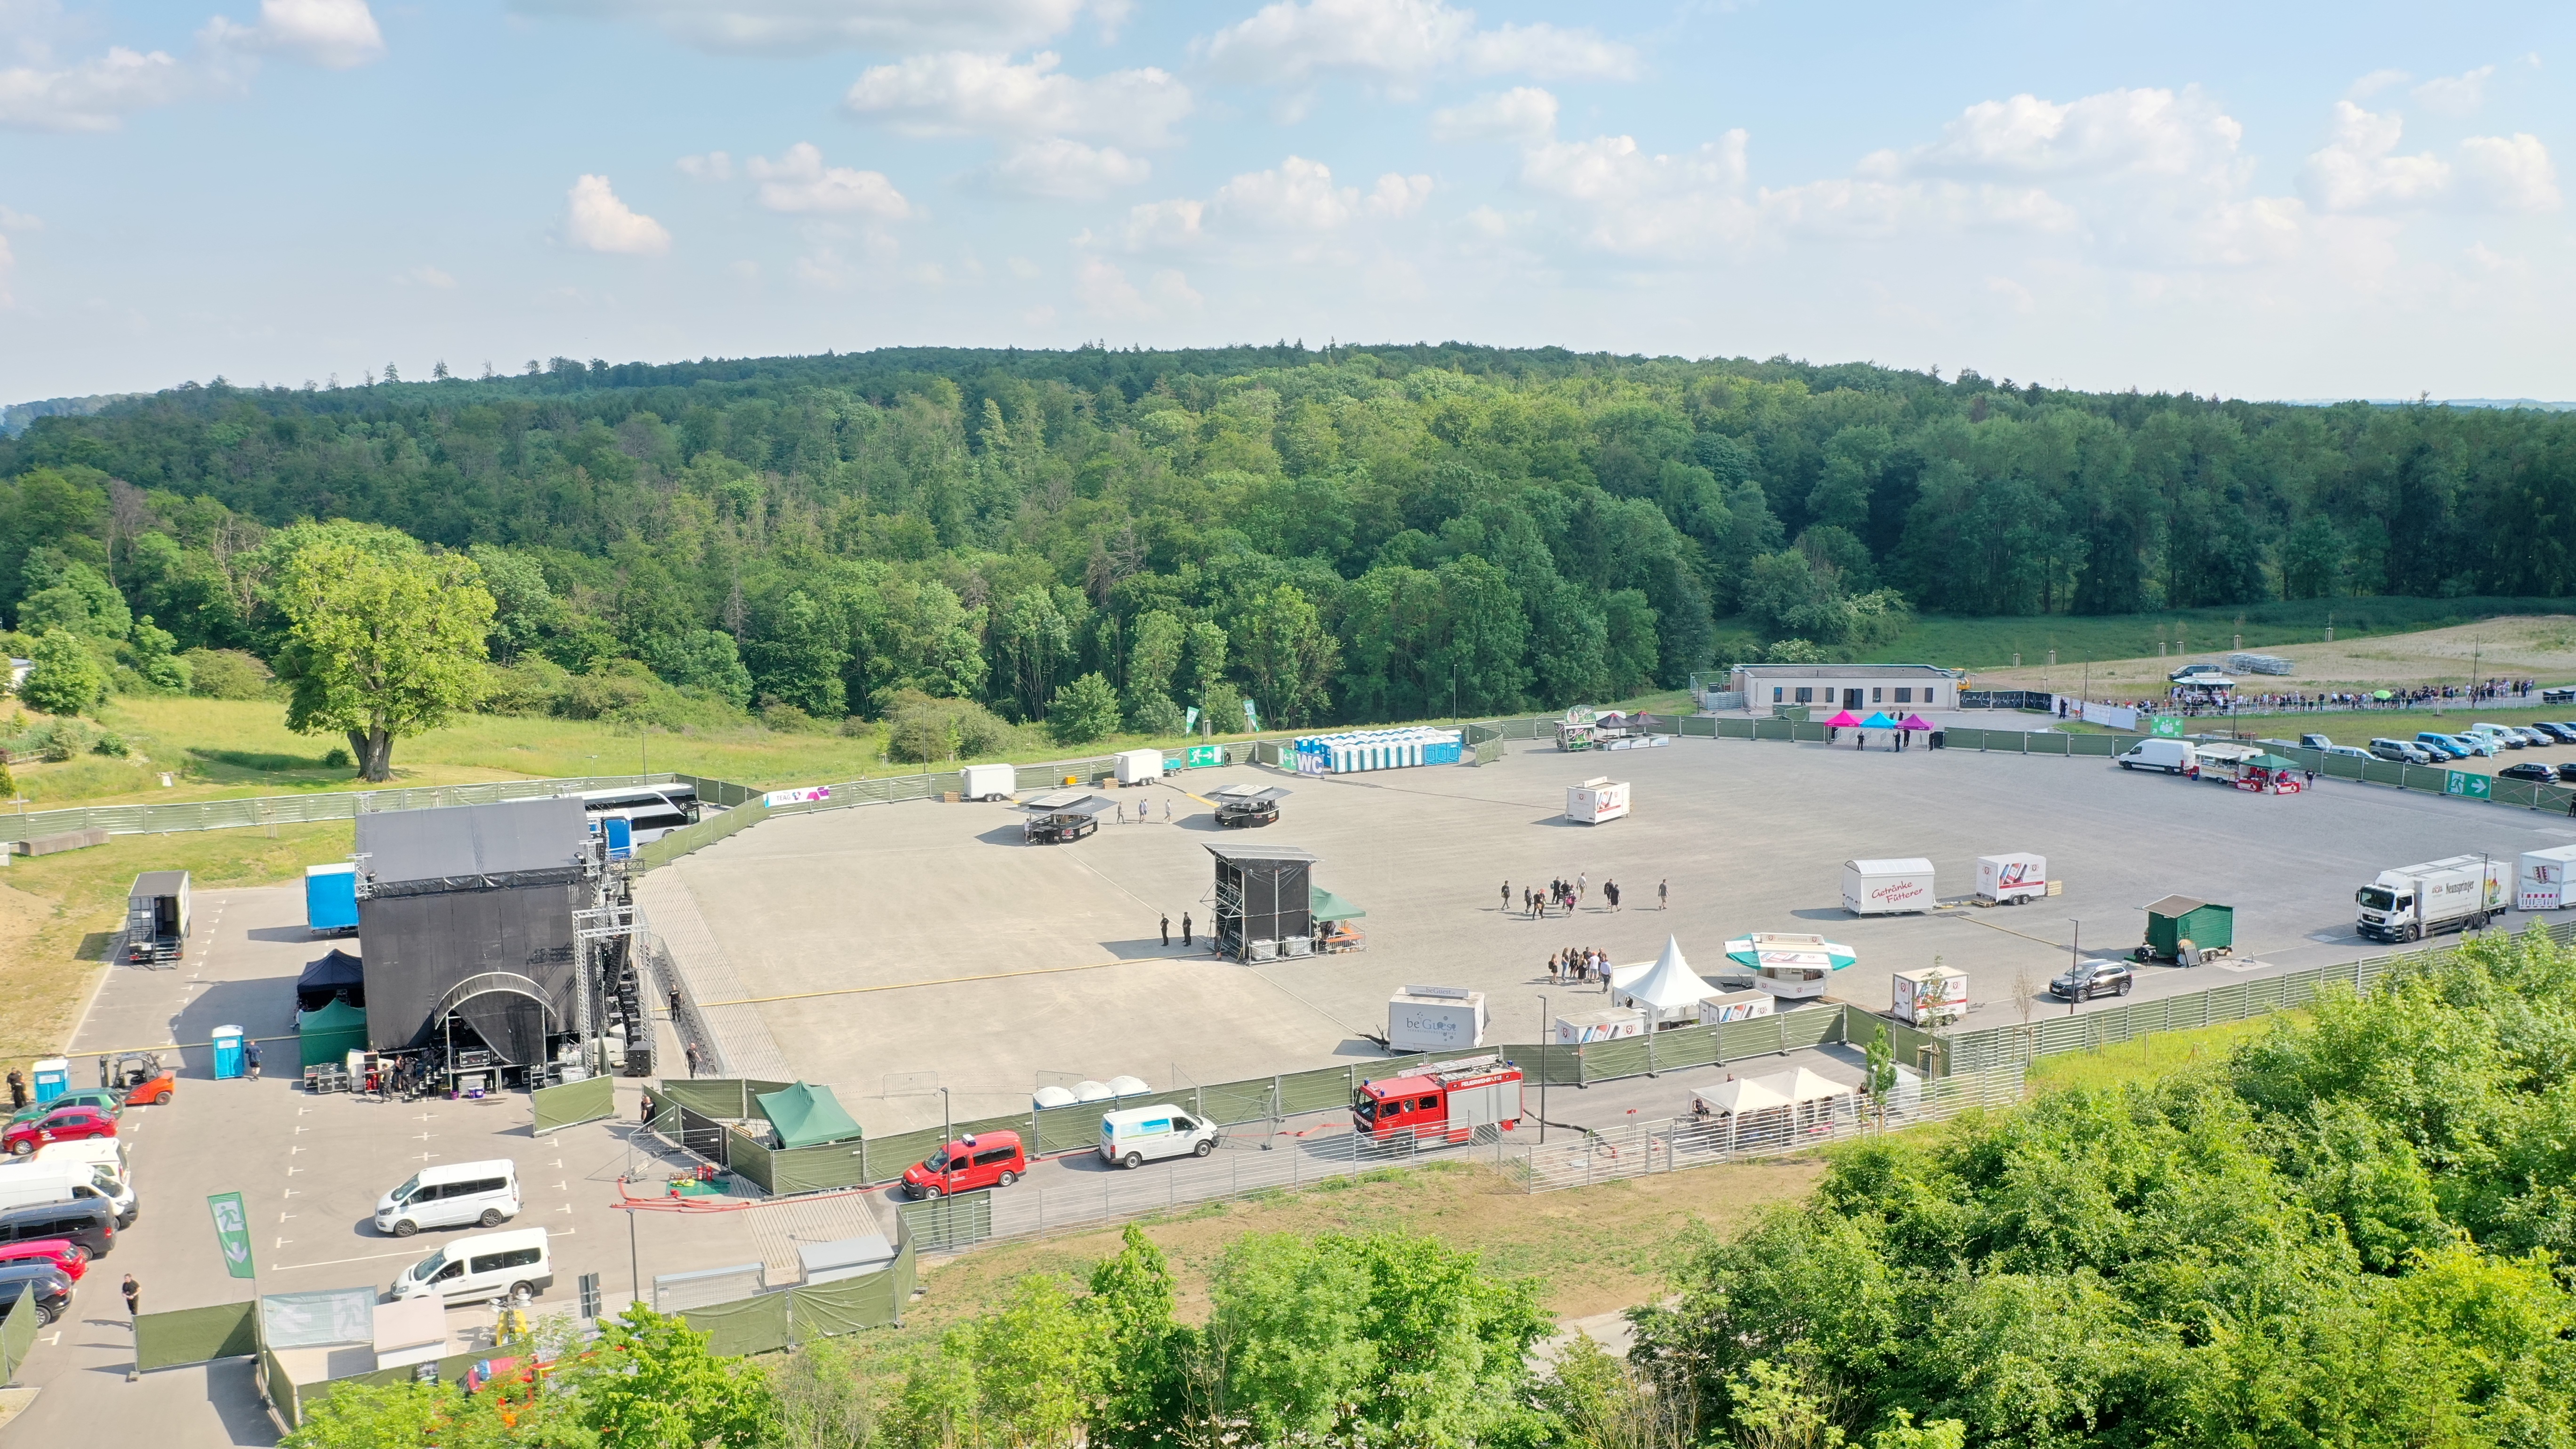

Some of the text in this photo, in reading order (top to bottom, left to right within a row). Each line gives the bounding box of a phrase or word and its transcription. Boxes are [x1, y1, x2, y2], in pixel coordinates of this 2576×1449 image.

[1296, 753, 1322, 773] WC
[1872, 880, 1913, 899] Getränke
[2446, 880, 2474, 894] Neunspringer
[1886, 888, 1923, 903] Fütterer
[1407, 1018, 1420, 1029] be
[1422, 1019, 1457, 1031] Guest
[1461, 1077, 1491, 1087] FEUERWEHR
